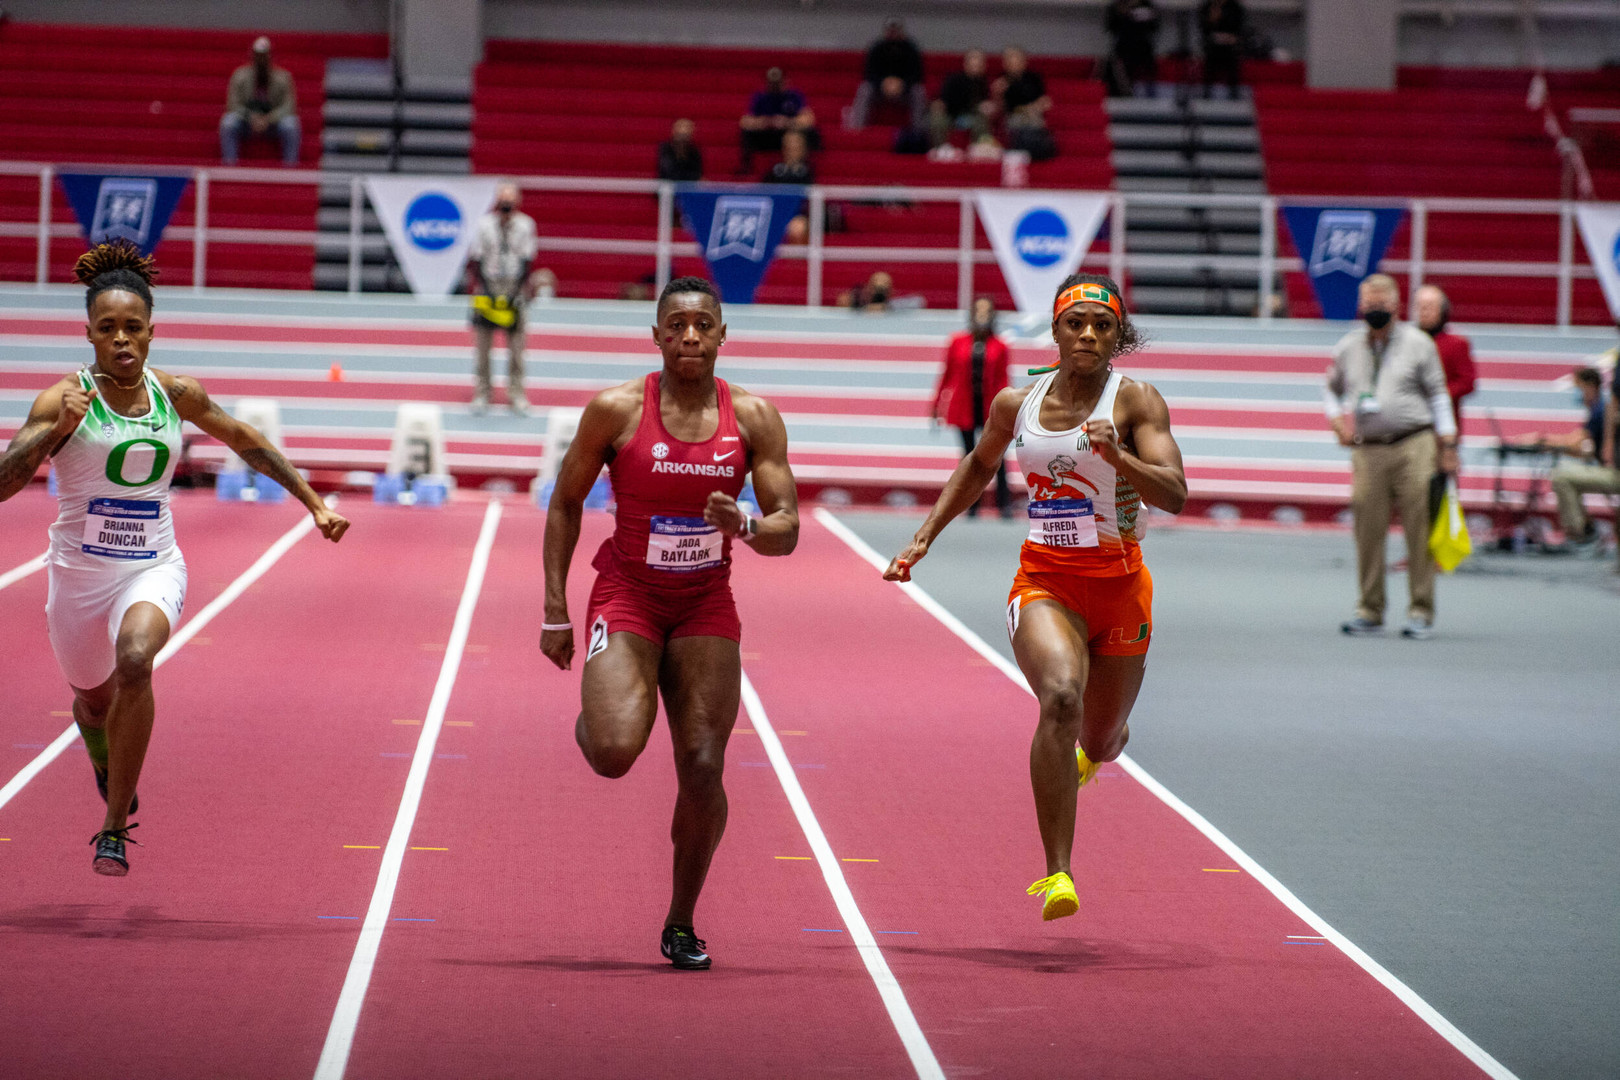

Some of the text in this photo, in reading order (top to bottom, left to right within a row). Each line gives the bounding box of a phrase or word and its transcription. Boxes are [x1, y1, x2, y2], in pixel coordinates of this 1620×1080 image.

[652, 442, 669, 459] SEC
[105, 438, 170, 488] O
[651, 460, 735, 478] ARKANSAS
[103, 519, 145, 533] BRIANNA
[1042, 520, 1078, 532] ALFREDA
[98, 531, 147, 547] DUNCAN
[676, 537, 701, 549] JADA
[1042, 533, 1080, 546] STEELE
[660, 547, 711, 562] BAYLARK
[590, 622, 604, 656] 2
